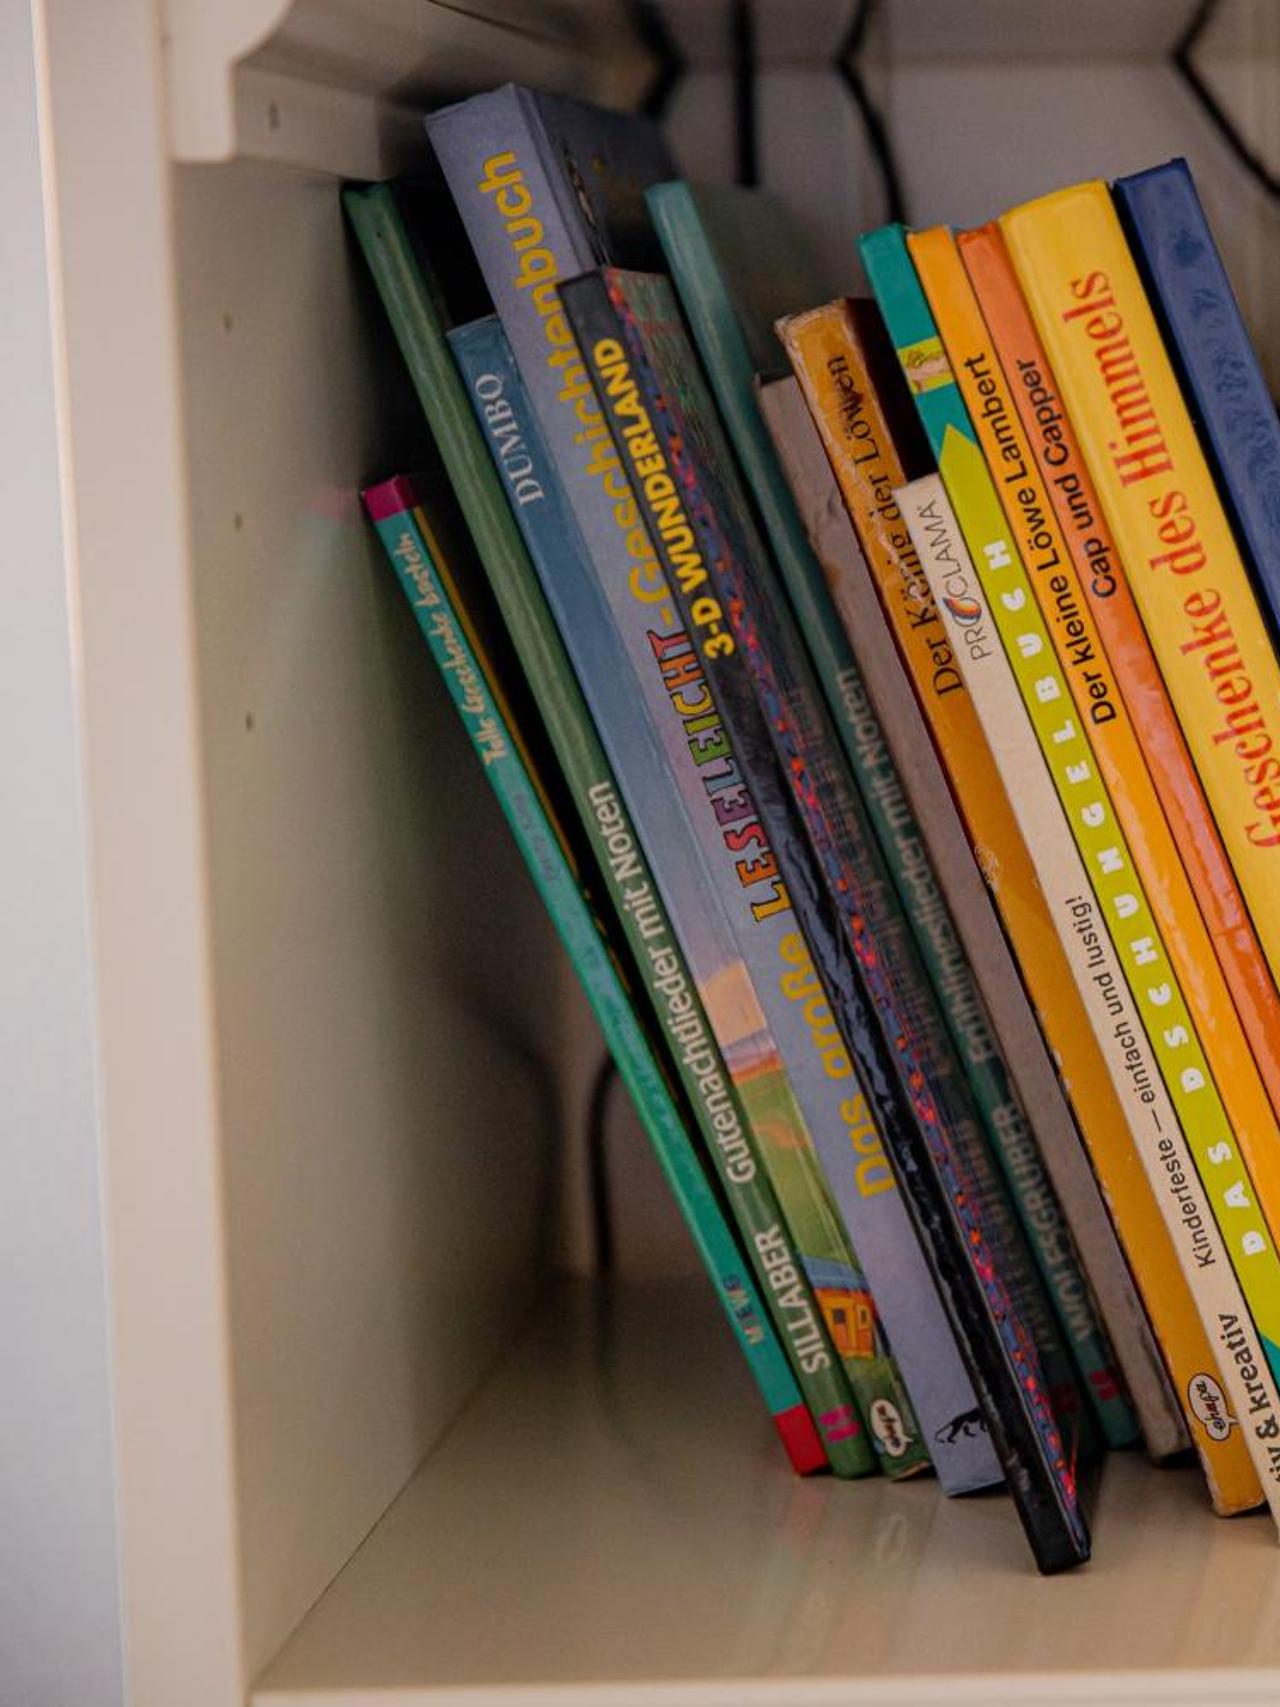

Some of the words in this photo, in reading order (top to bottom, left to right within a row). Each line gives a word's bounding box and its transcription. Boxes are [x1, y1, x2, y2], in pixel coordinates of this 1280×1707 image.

[826, 354, 881, 466] Löwen
[964, 352, 1029, 484] Lambert
[1016, 358, 1070, 467] Capper
[1061, 270, 1174, 488] Himmels
[474, 372, 545, 506] DUMBO
[593, 336, 708, 593] WUNDERLAND
[868, 473, 901, 523] der
[1016, 486, 1061, 572] Löwe
[1054, 470, 1095, 530] und
[1148, 490, 1207, 577] des
[392, 530, 442, 608] basteln
[1083, 536, 1117, 600] Cap
[432, 611, 486, 714] Geschenke
[690, 596, 735, 659] 3-D
[924, 637, 965, 697] Der
[1050, 574, 1097, 667] kleine
[475, 715, 509, 766] Tolle
[837, 668, 890, 770] Noten
[1082, 669, 1117, 726] Der
[588, 781, 643, 883] Noten
[871, 772, 913, 829] mit
[982, 538, 1206, 1094] DSCHUNGELBUCH
[623, 881, 665, 940] mit
[894, 833, 997, 1064] Frühlingslieder
[1064, 895, 1106, 968] lustig!
[778, 931, 852, 1081] große
[1092, 971, 1124, 1016] und
[647, 945, 758, 1184] Gutenachtlieder
[1114, 1021, 1156, 1104] einfach
[840, 1098, 897, 1198] Das
[1207, 1141, 1267, 1256] DAS
[990, 1102, 1094, 1343] WOLFSGRUBER
[1158, 1137, 1216, 1268] Kinderfeste
[753, 1223, 832, 1374] SILLABER
[1218, 1312, 1271, 1416] kreativ
[1255, 1413, 1280, 1440] &
